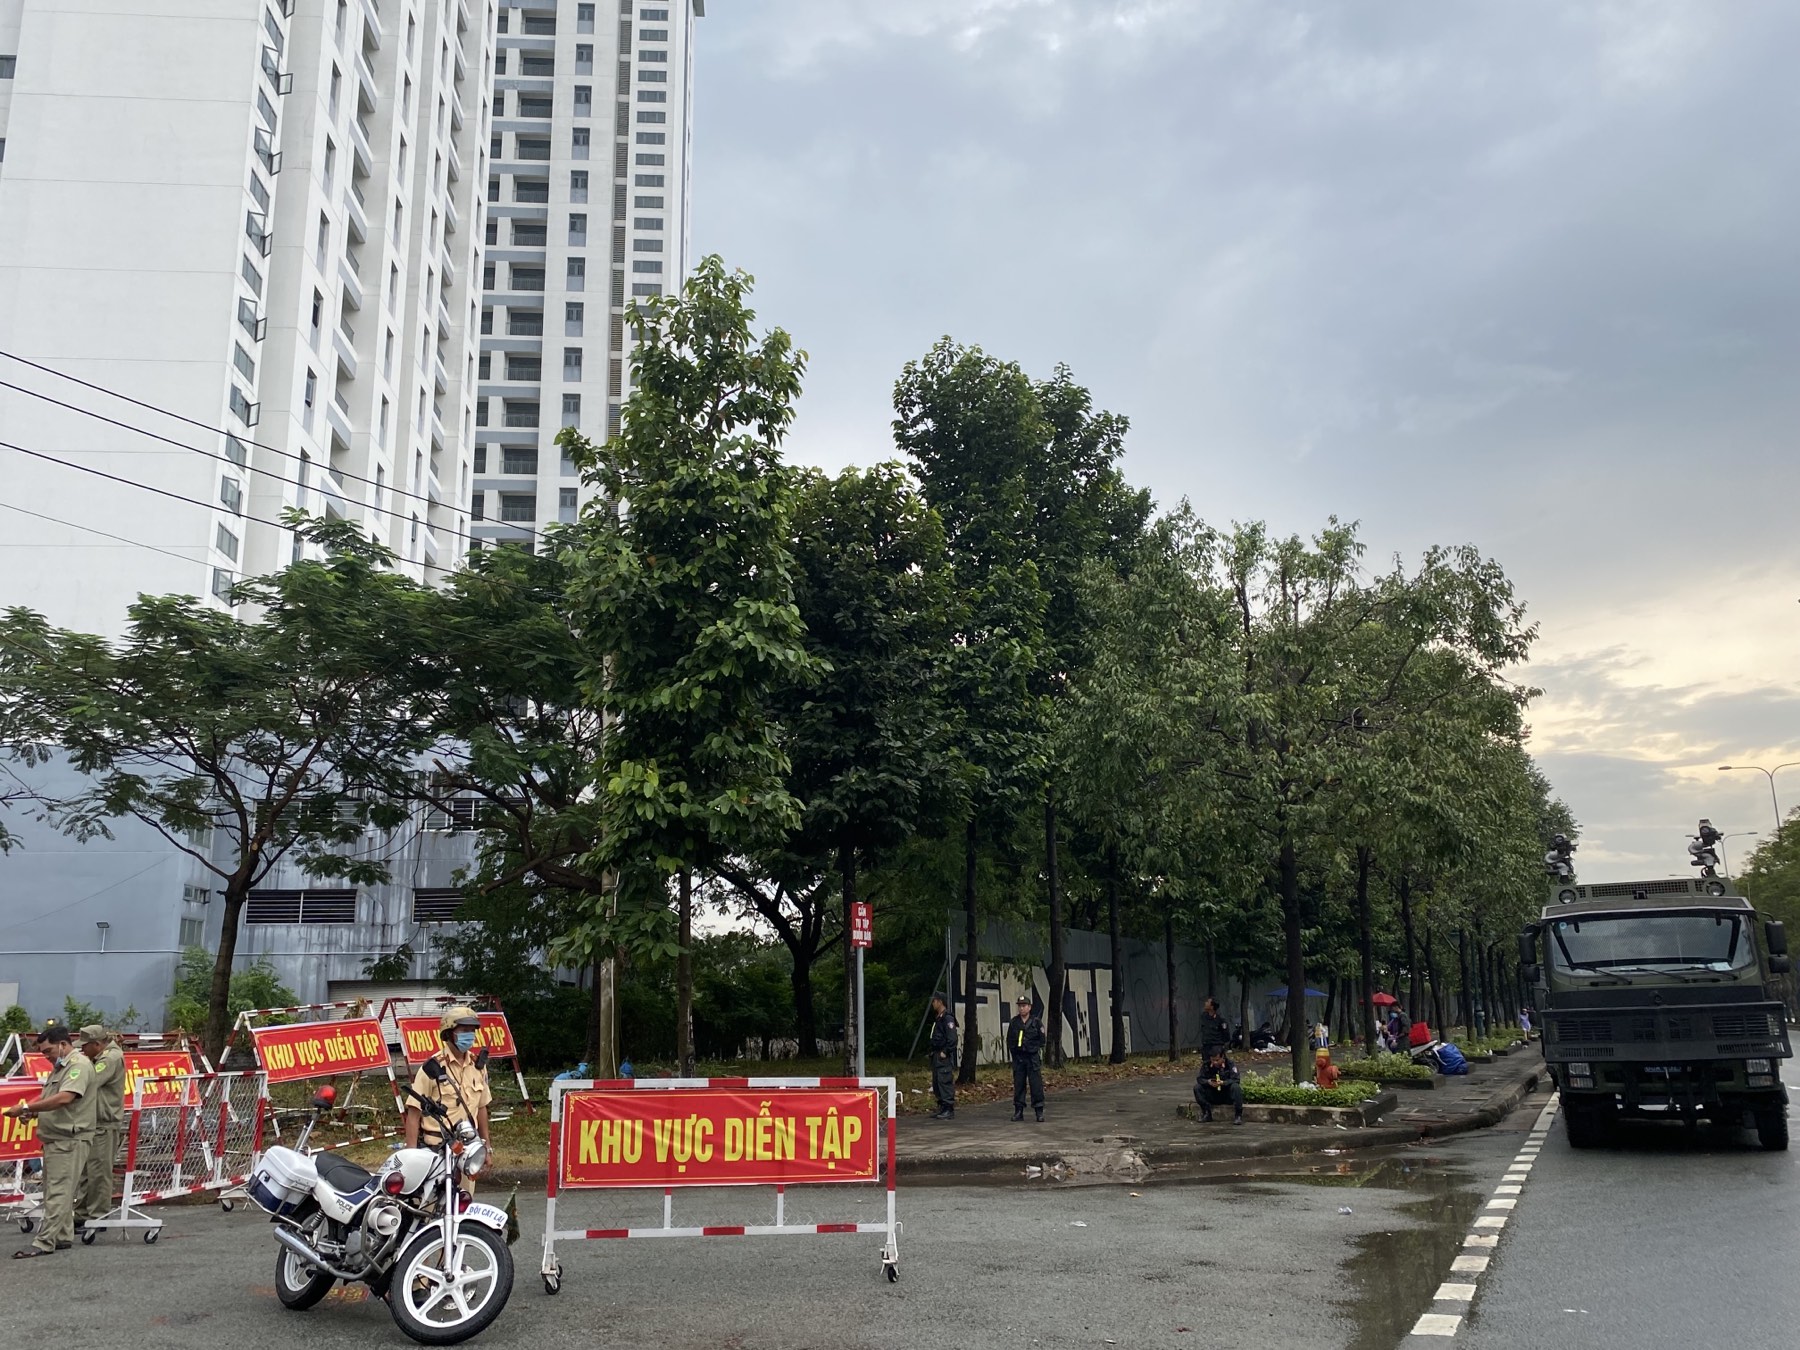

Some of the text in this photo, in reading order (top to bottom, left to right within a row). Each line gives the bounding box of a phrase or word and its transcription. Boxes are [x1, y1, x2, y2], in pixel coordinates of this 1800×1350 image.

[263, 1028, 379, 1071] KHU VỰC DIỄN TẬP
[407, 1030, 434, 1052] KHU
[579, 1100, 862, 1173] KHU VỰC DIỄN TẬP
